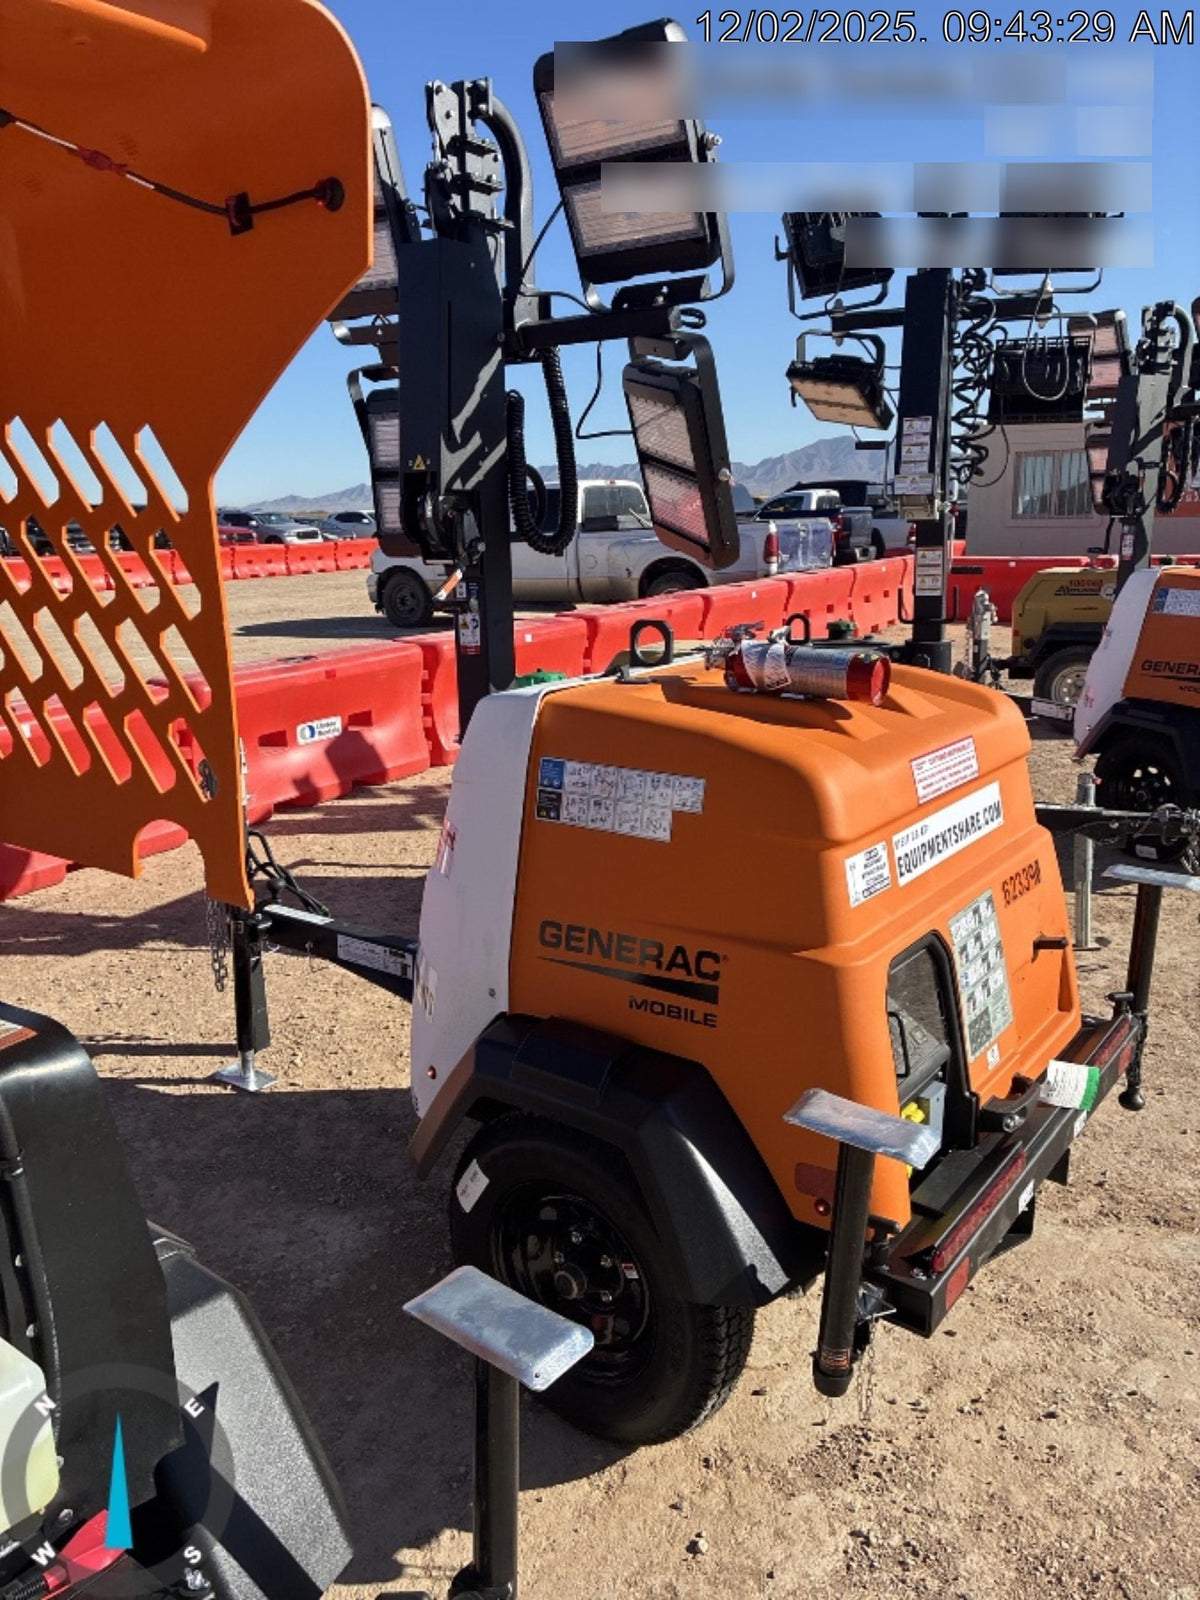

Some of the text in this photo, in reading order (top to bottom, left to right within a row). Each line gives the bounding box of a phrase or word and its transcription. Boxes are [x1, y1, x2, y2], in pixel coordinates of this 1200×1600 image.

[1142, 659, 1200, 675] GENER
[896, 800, 1002, 878] EQUIPMENTSHARE.COM
[539, 919, 722, 982] GENERAC
[628, 995, 719, 1029] MOBILE
